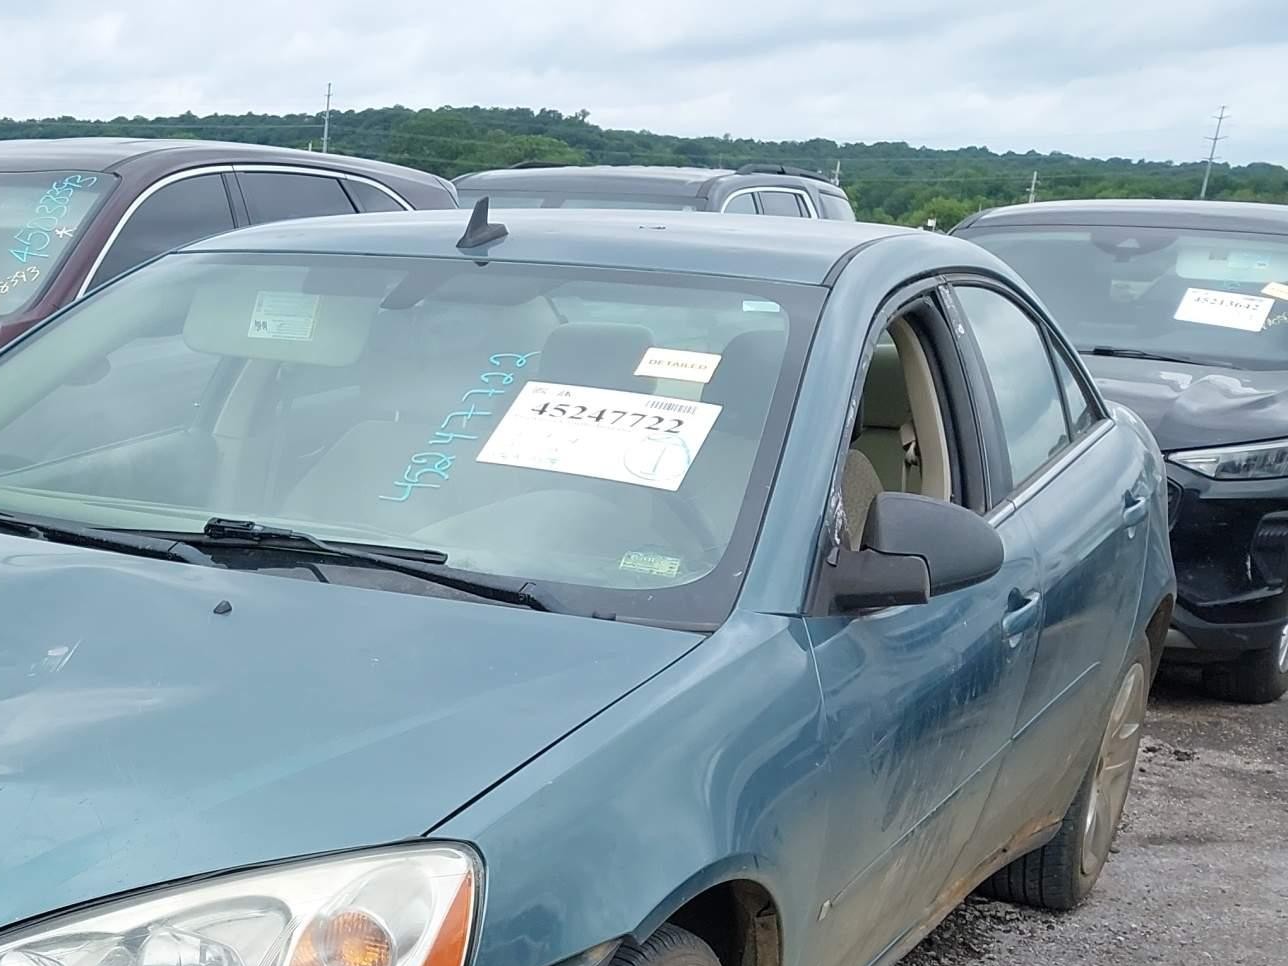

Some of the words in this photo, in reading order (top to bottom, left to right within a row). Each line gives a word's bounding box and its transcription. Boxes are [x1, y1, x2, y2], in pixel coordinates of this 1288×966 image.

[648, 359, 708, 370] DETAILED
[378, 351, 543, 502] 45247722
[530, 401, 685, 434] 45247722
